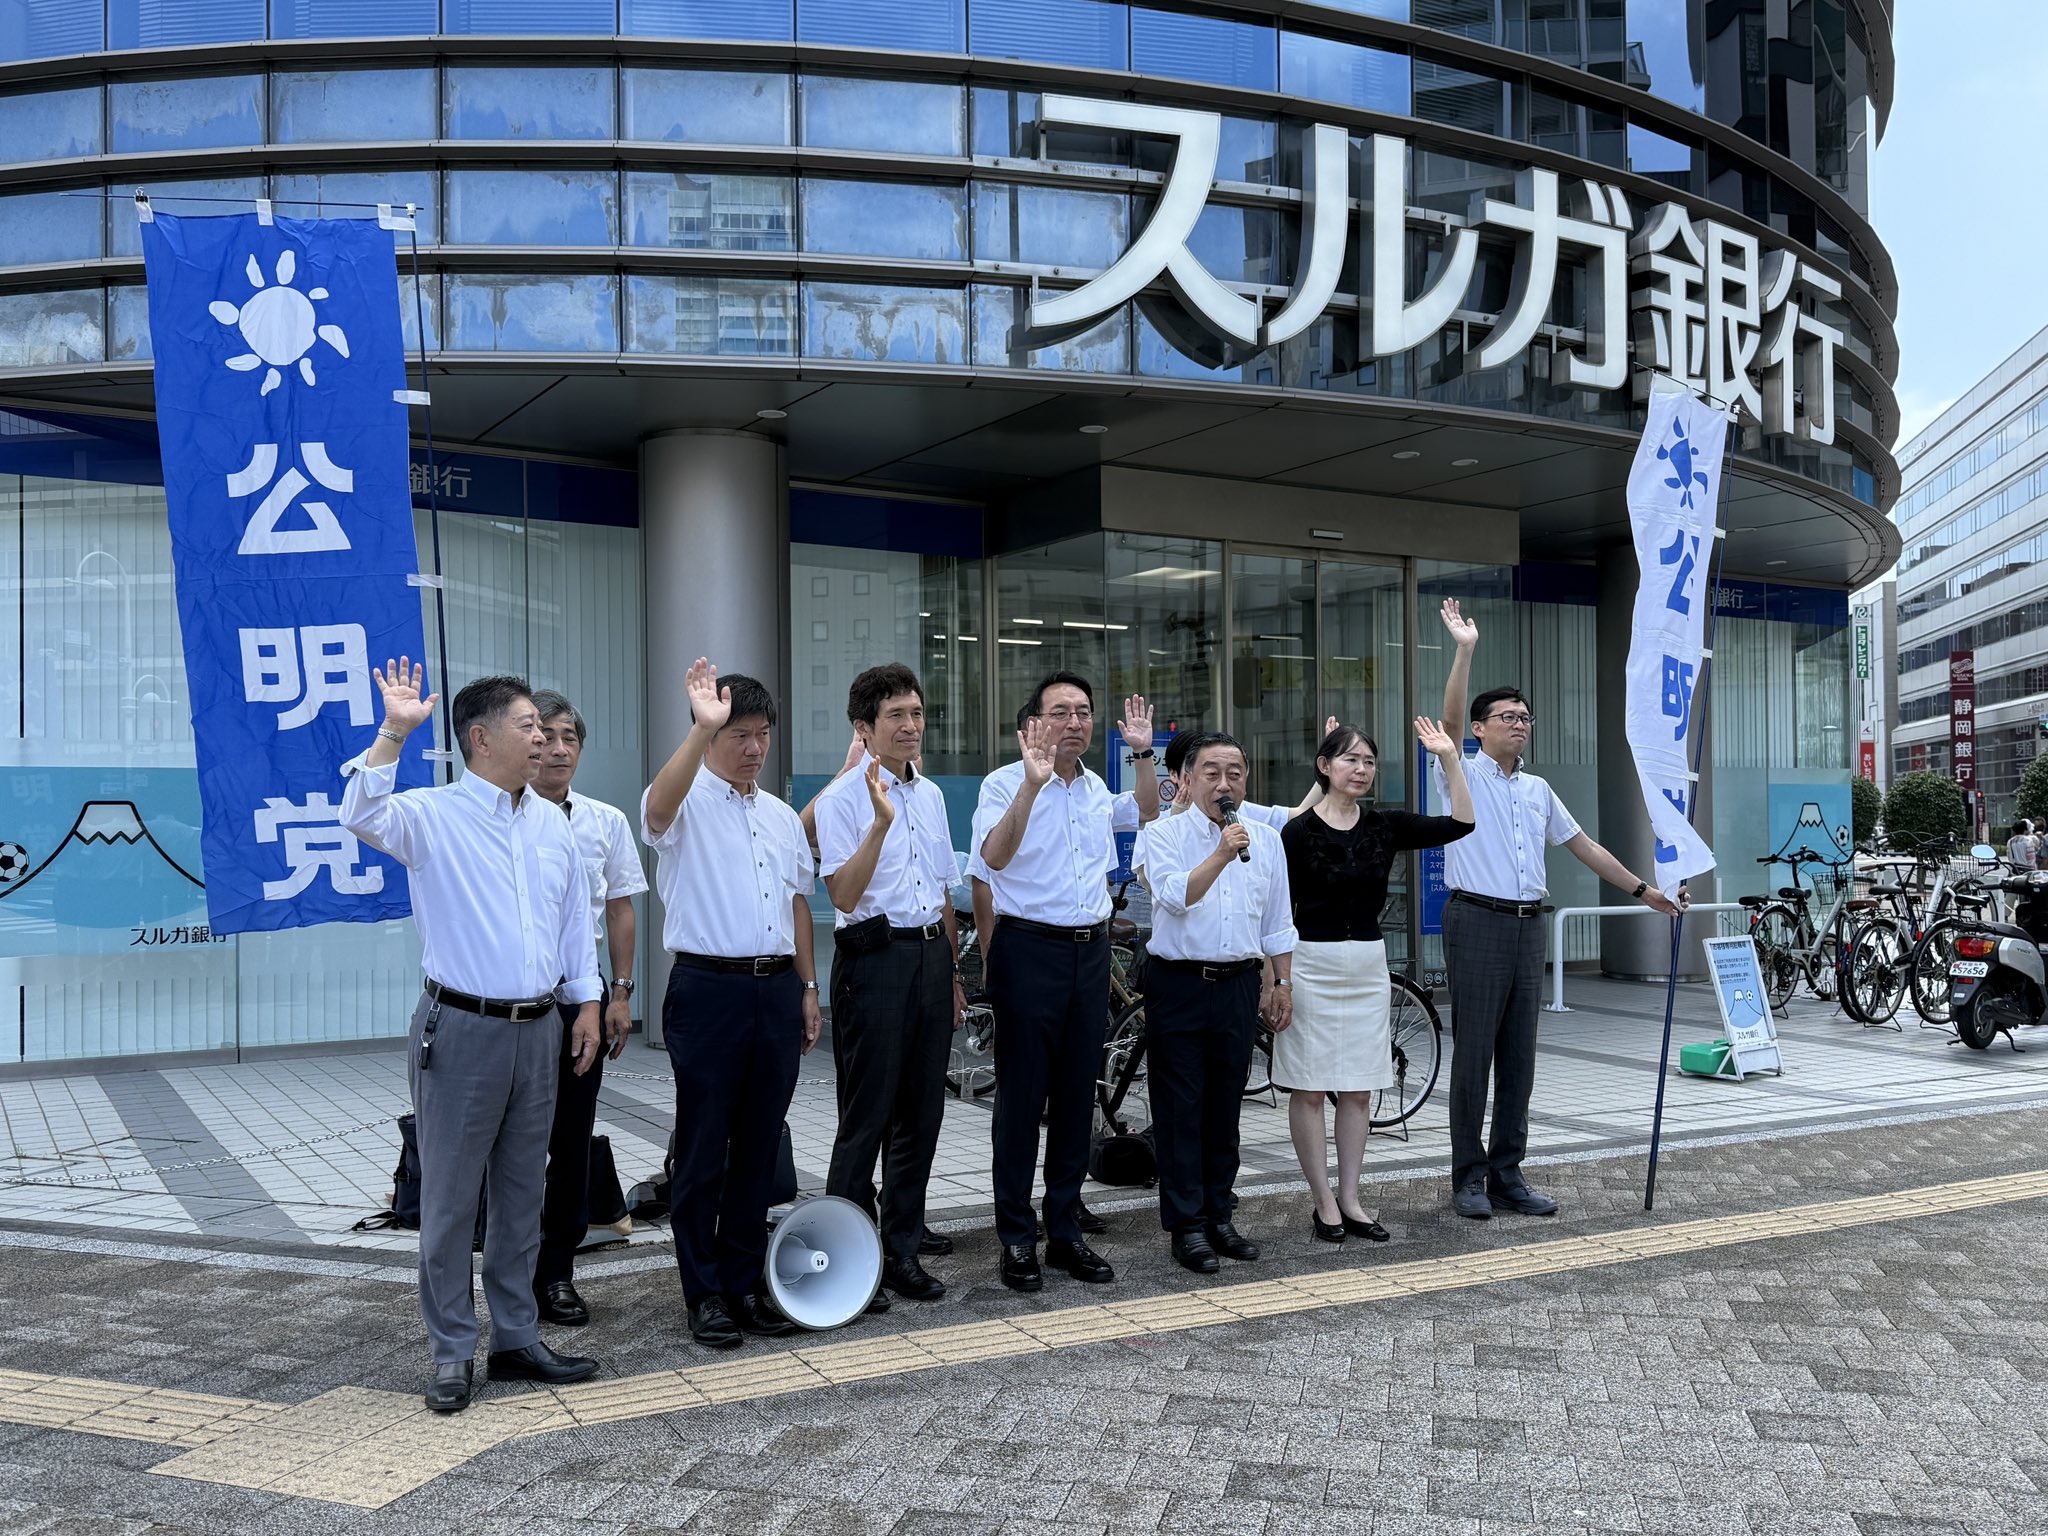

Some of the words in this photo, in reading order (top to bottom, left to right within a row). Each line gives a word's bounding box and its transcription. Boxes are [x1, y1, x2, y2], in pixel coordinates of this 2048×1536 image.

[1030, 92, 1844, 446] スルガ銀行
[227, 442, 384, 900] 公明党
[1857, 626, 1867, 677] トヨタレンタカー
[1954, 699, 1972, 779] 静岡銀行
